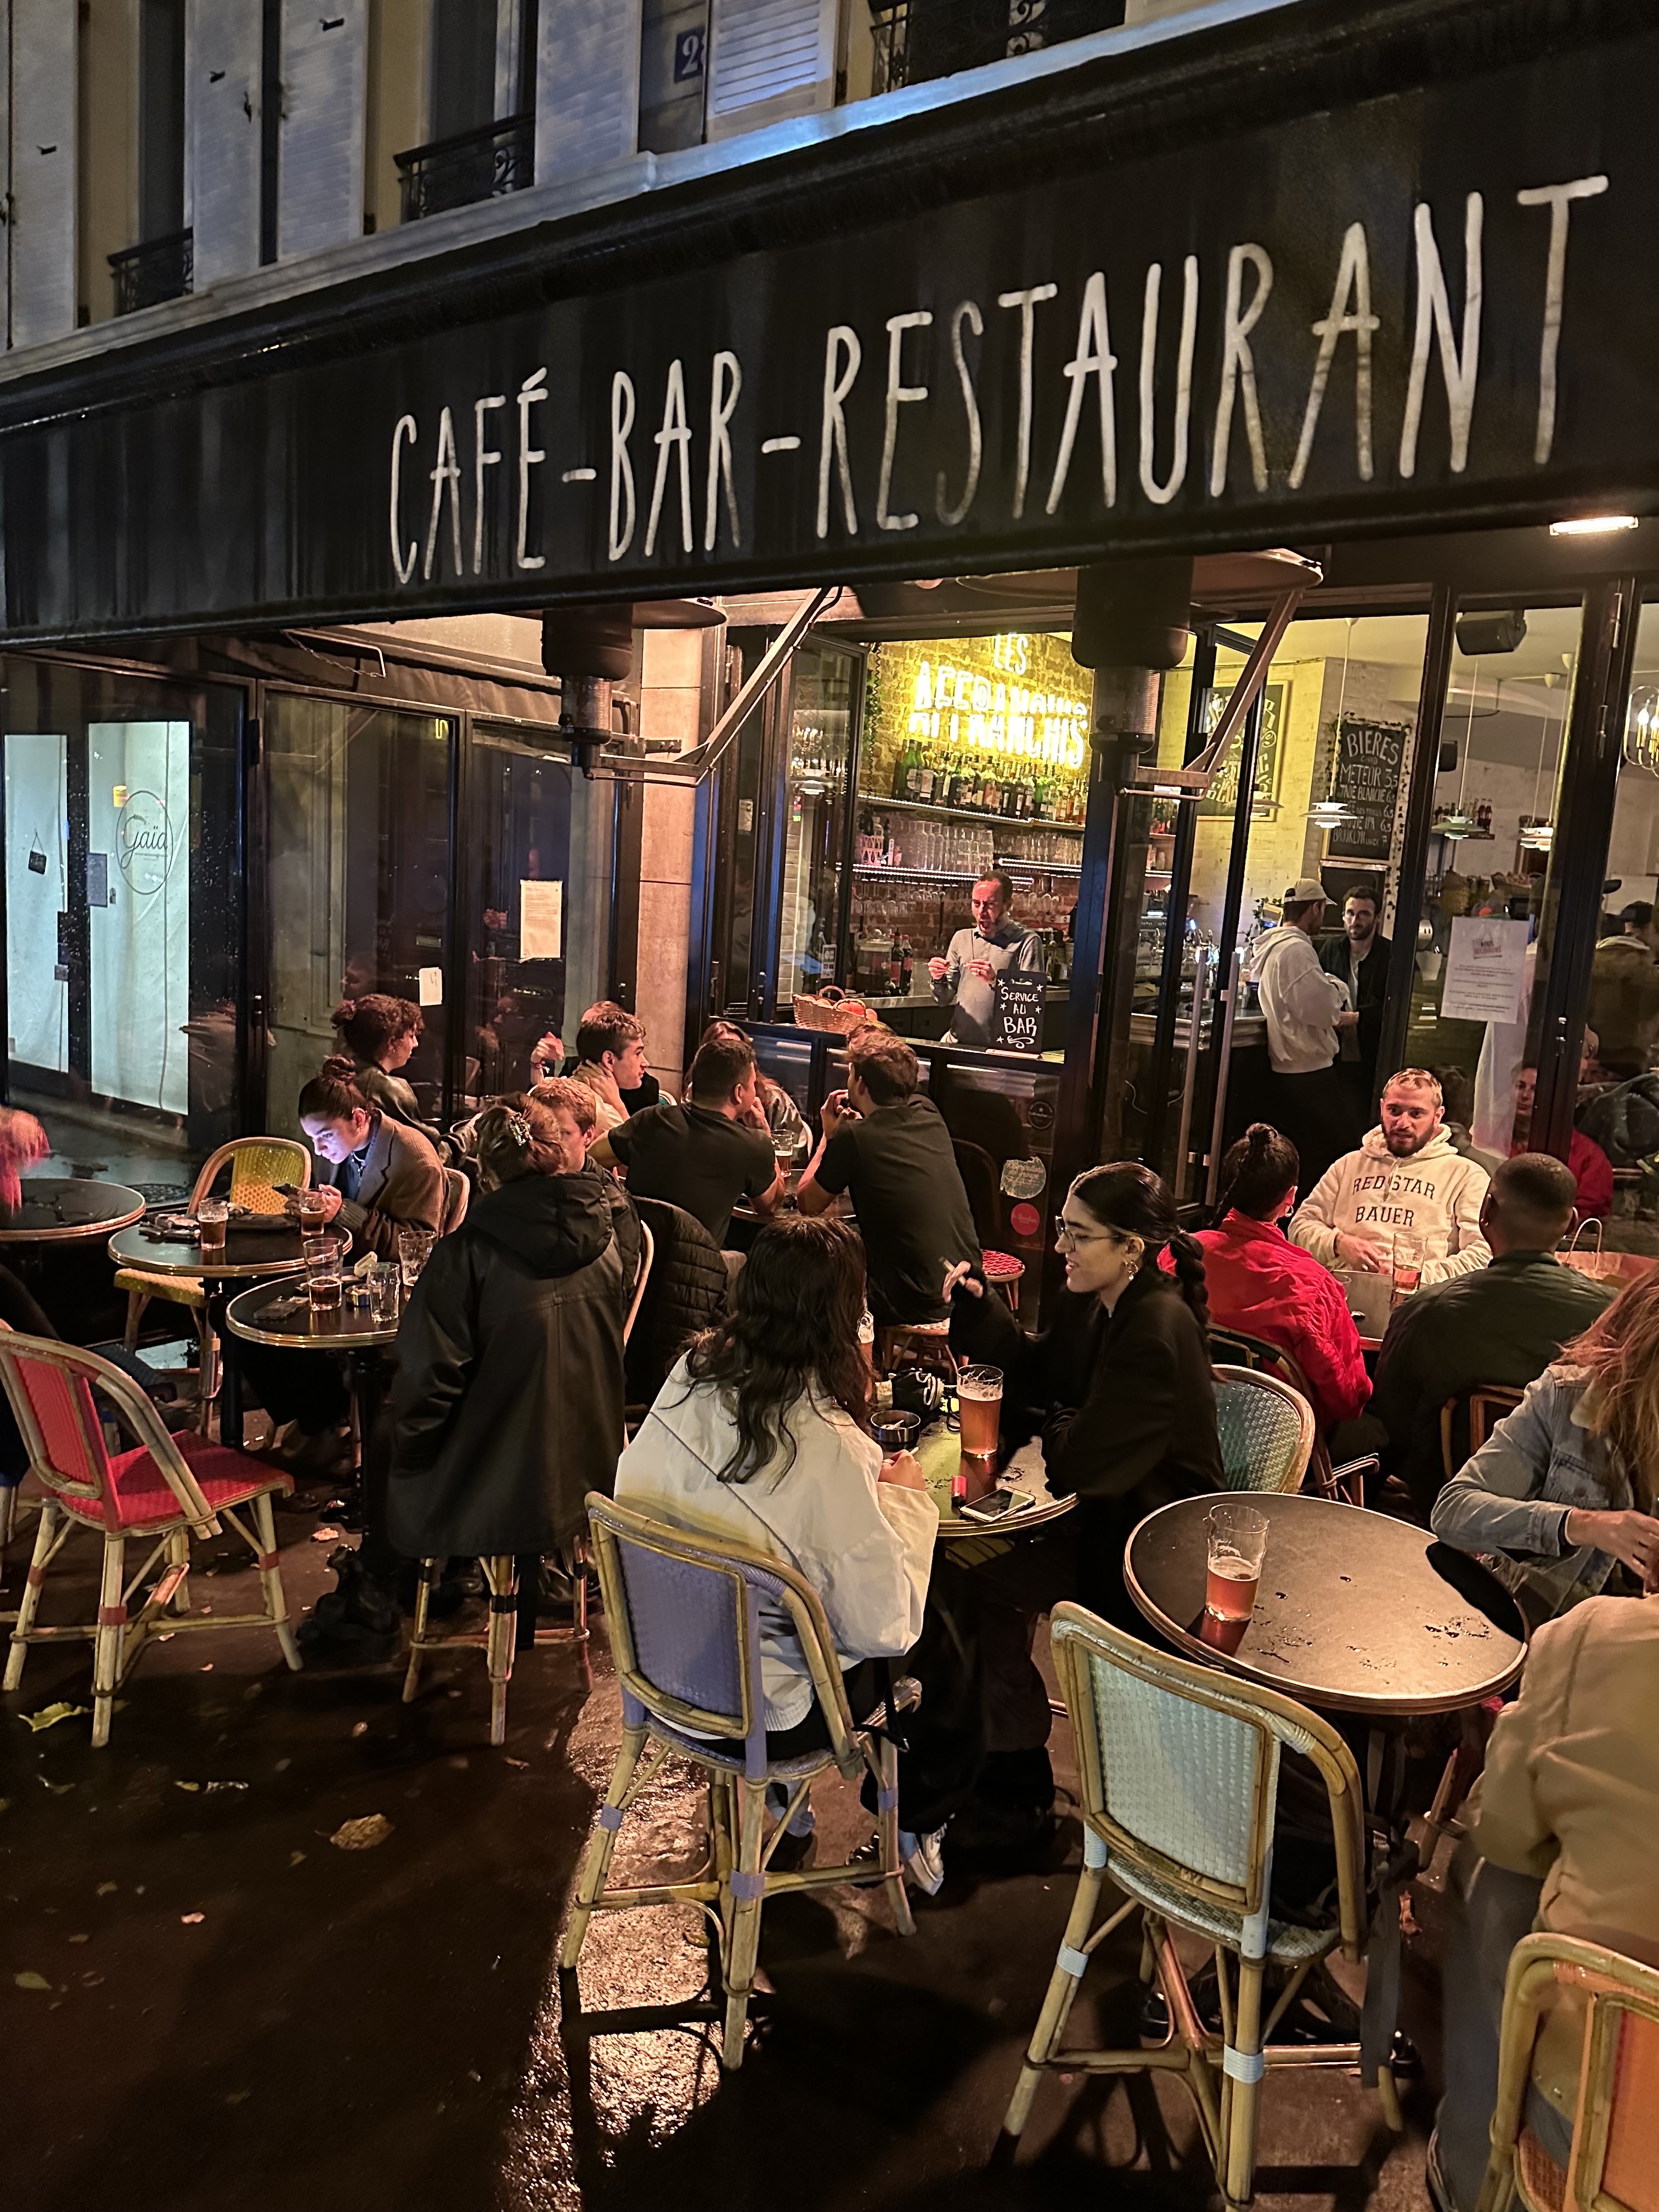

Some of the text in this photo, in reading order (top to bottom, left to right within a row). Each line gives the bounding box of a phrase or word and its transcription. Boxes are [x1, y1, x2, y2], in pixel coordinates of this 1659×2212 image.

[681, 35, 707, 75] 2
[994, 632, 1028, 675] LES
[1347, 730, 1400, 765] BIERES
[1001, 986, 1039, 1002] SERVICE
[1013, 1003, 1026, 1014] AU
[1003, 1016, 1037, 1037] BAR
[1352, 1175, 1436, 1200] RED STAR
[1355, 1206, 1415, 1227] BAUER
